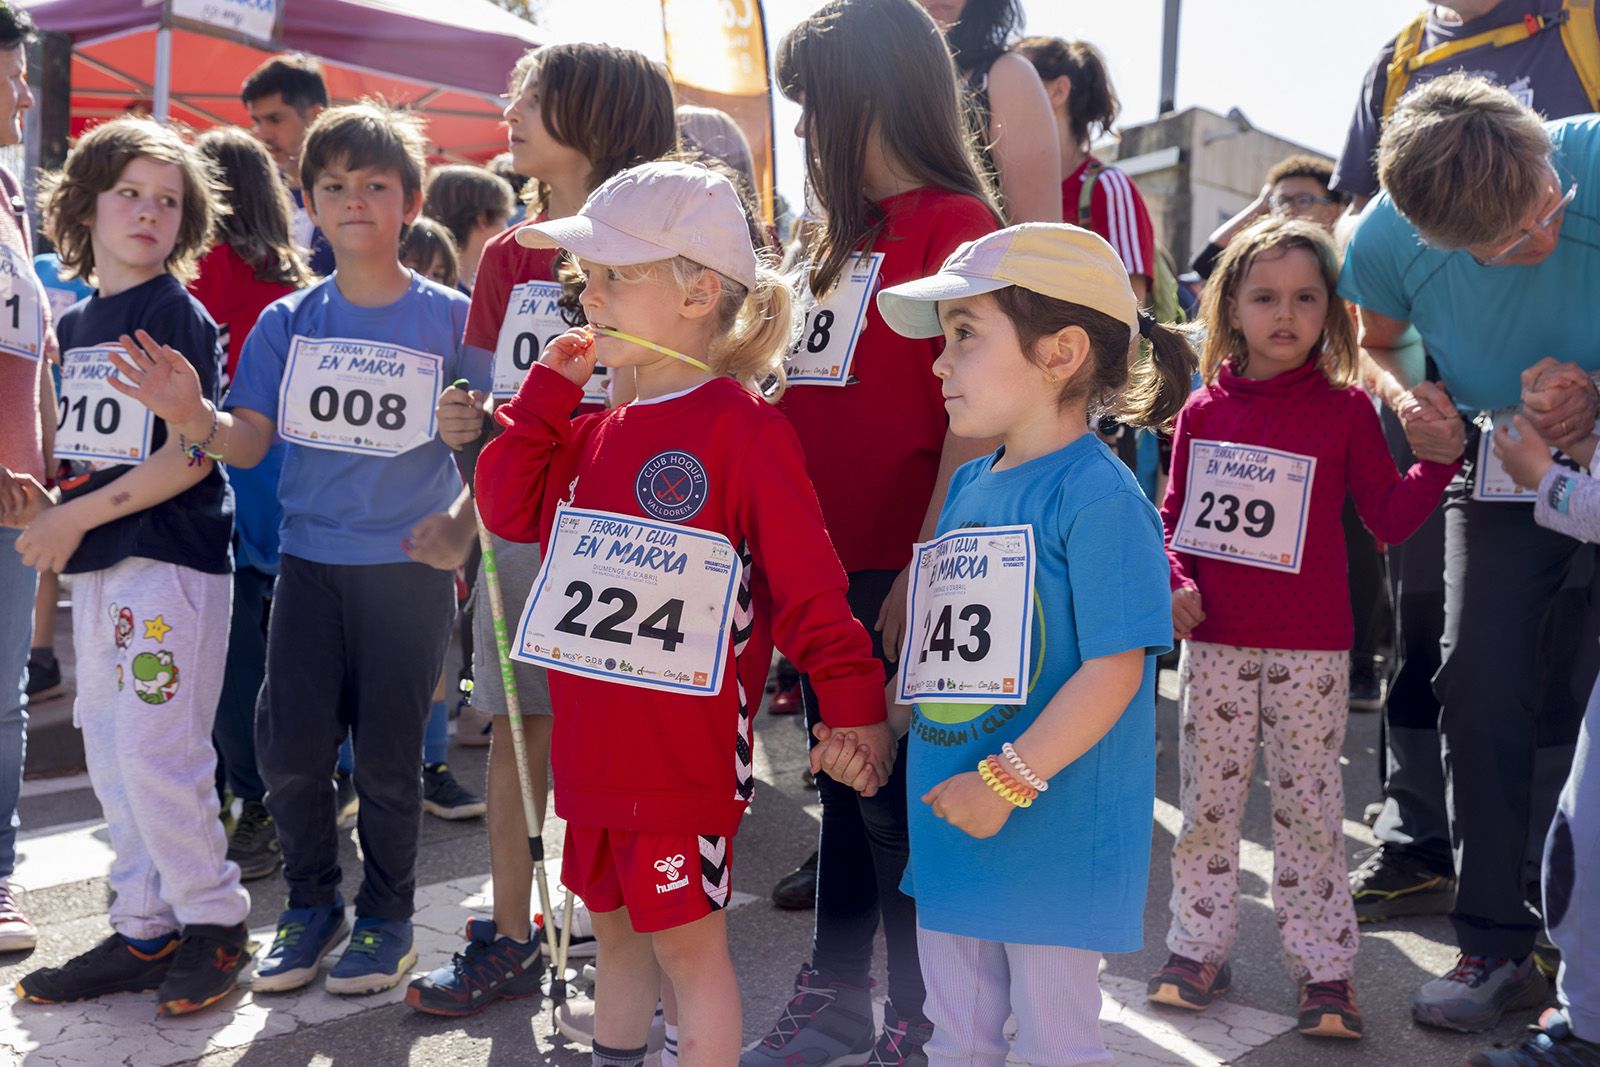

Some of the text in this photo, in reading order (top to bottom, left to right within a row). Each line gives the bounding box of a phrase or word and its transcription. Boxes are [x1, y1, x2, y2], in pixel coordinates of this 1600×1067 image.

[517, 299, 541, 315] EN
[317, 355, 344, 371] EN
[347, 357, 406, 378] MARXA
[309, 385, 407, 431] 008
[644, 455, 703, 484] CLUB HOQUEI
[1205, 459, 1221, 476] EN
[1222, 461, 1276, 484] MARXA
[647, 498, 692, 517] VALLDOREIX
[1194, 491, 1275, 538] 239
[588, 519, 679, 548] FERRAN I CLUA
[955, 537, 978, 553] CLUA
[573, 535, 688, 575] EN MARXA
[938, 554, 989, 583] MARXA
[592, 563, 626, 576] DIUMENGE
[554, 580, 685, 652] 224
[918, 603, 992, 665] 243
[915, 720, 968, 747] FERRAN
[655, 874, 690, 894] hummel
